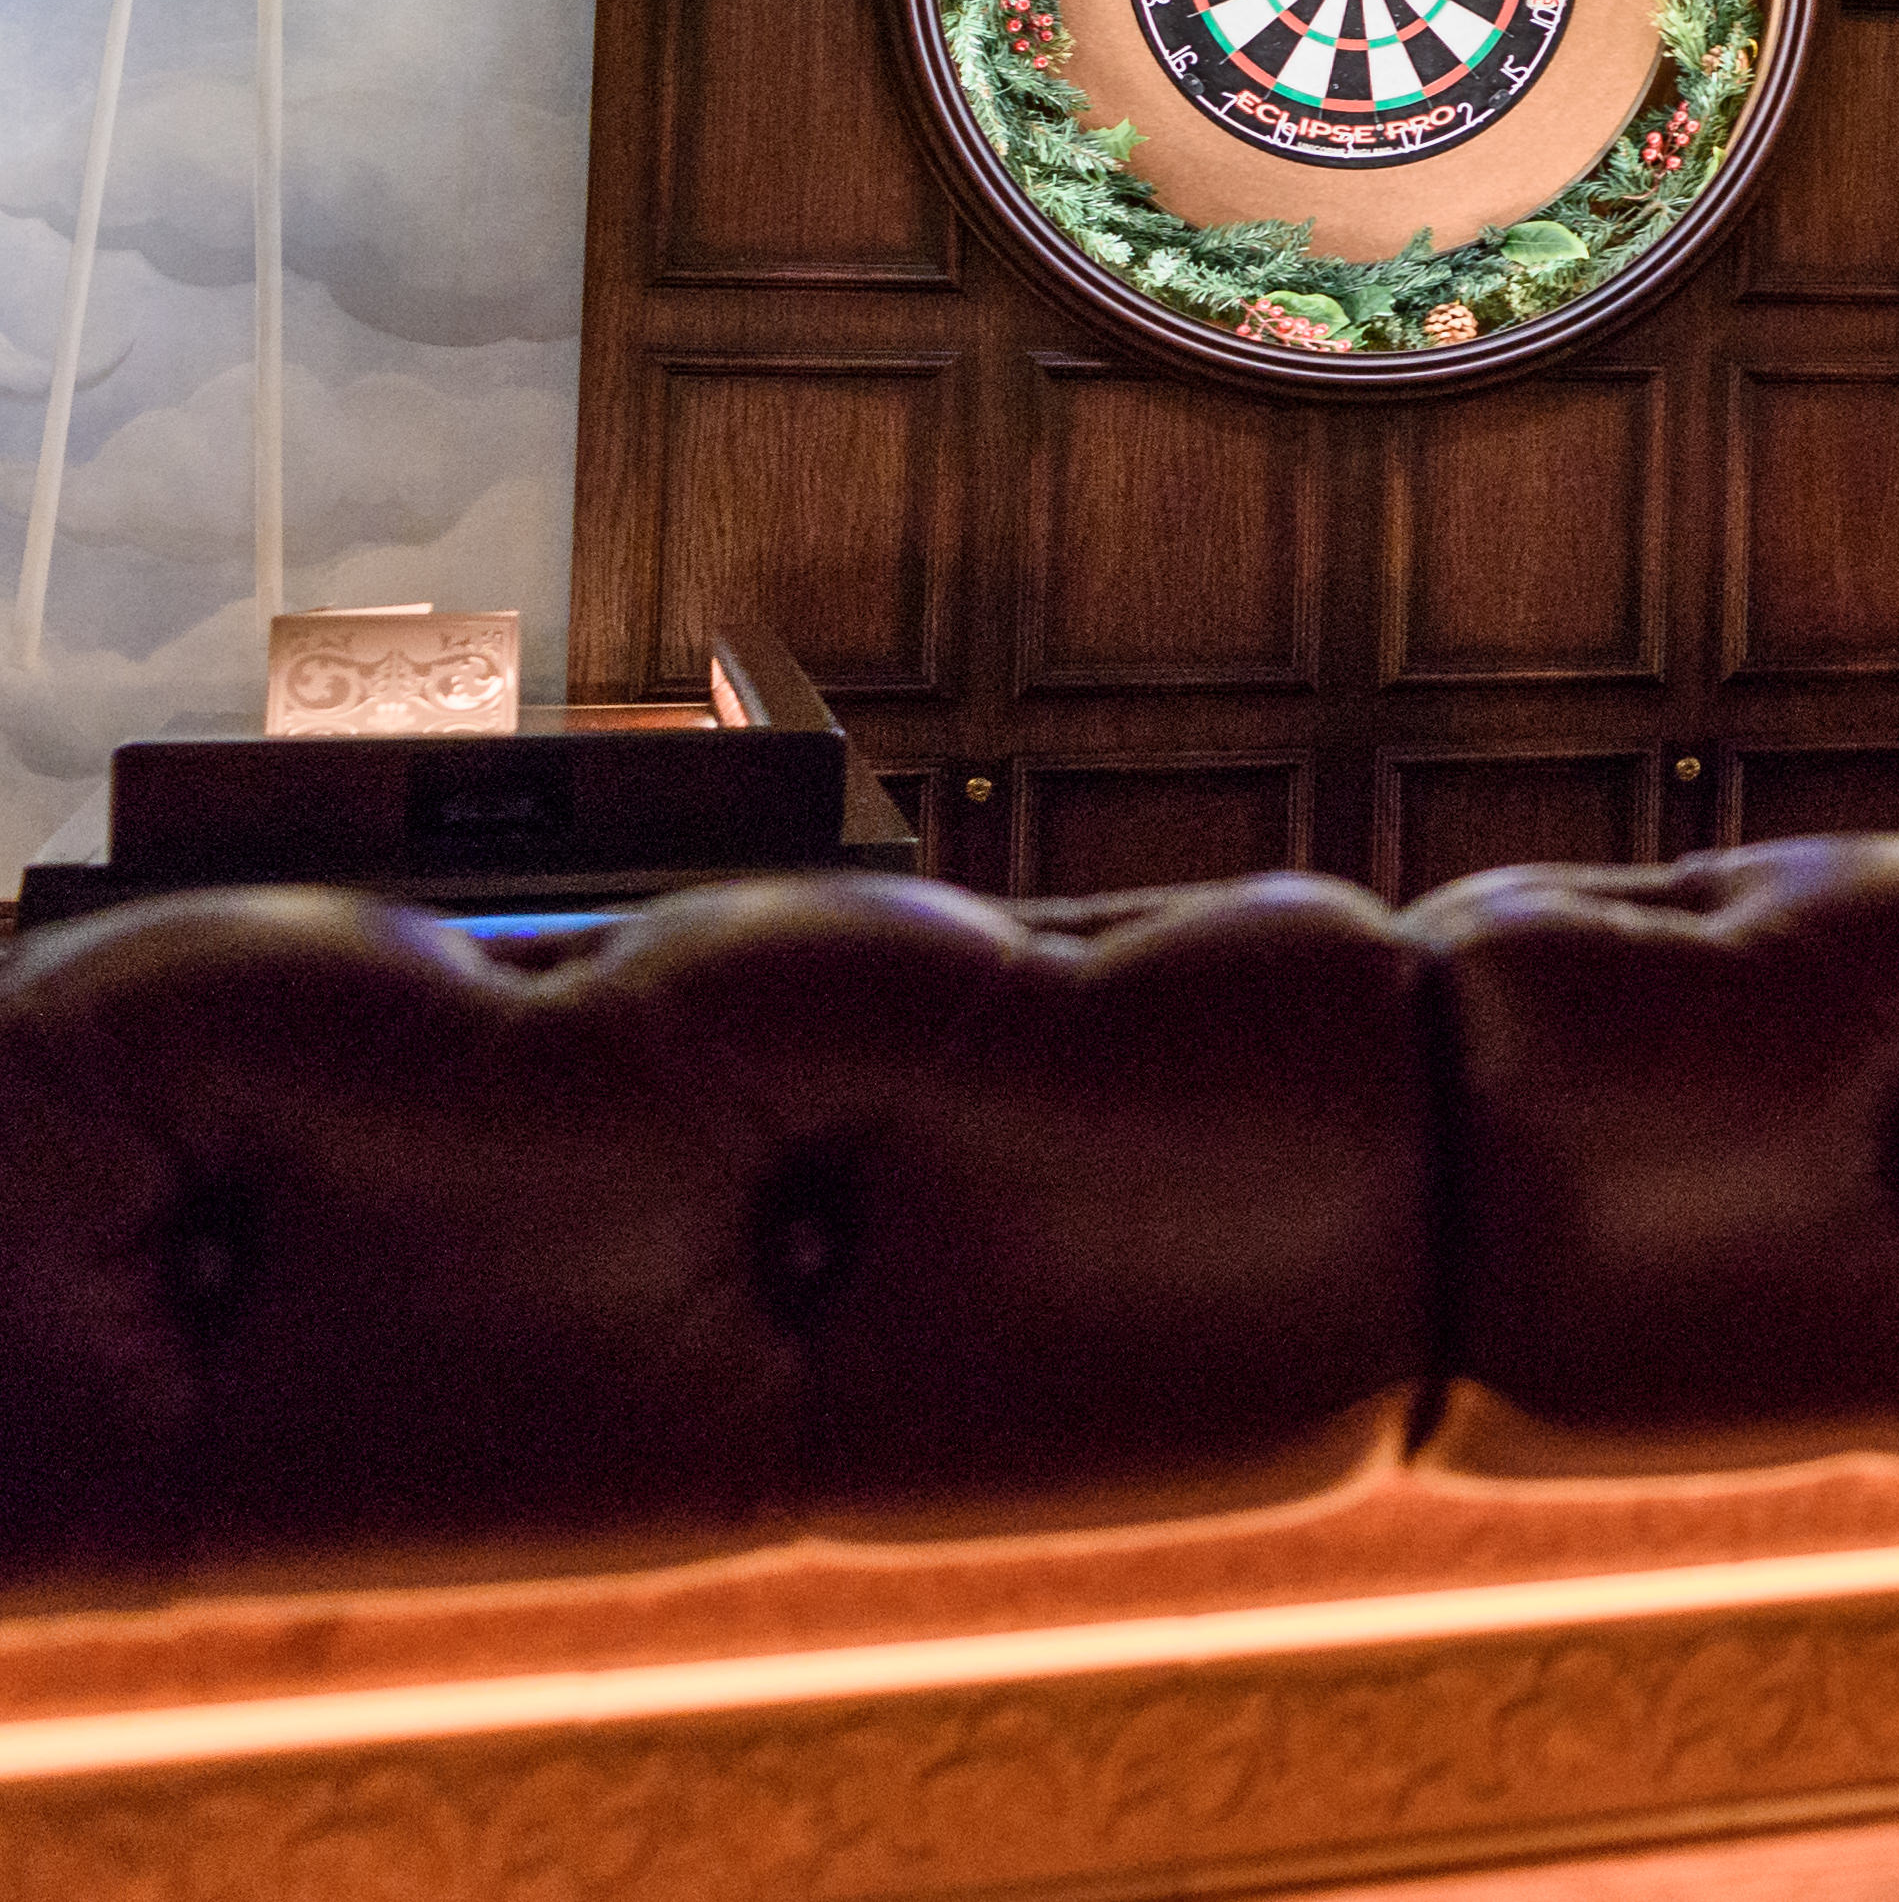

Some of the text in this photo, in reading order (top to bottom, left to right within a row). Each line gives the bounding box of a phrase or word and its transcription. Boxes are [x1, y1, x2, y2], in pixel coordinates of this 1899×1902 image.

[1529, 8, 1562, 36] 10
[1166, 44, 1198, 74] 16
[1500, 55, 1530, 88] 15
[1234, 88, 1456, 144] ECLIPSE PRO
[1457, 102, 1482, 127] 2
